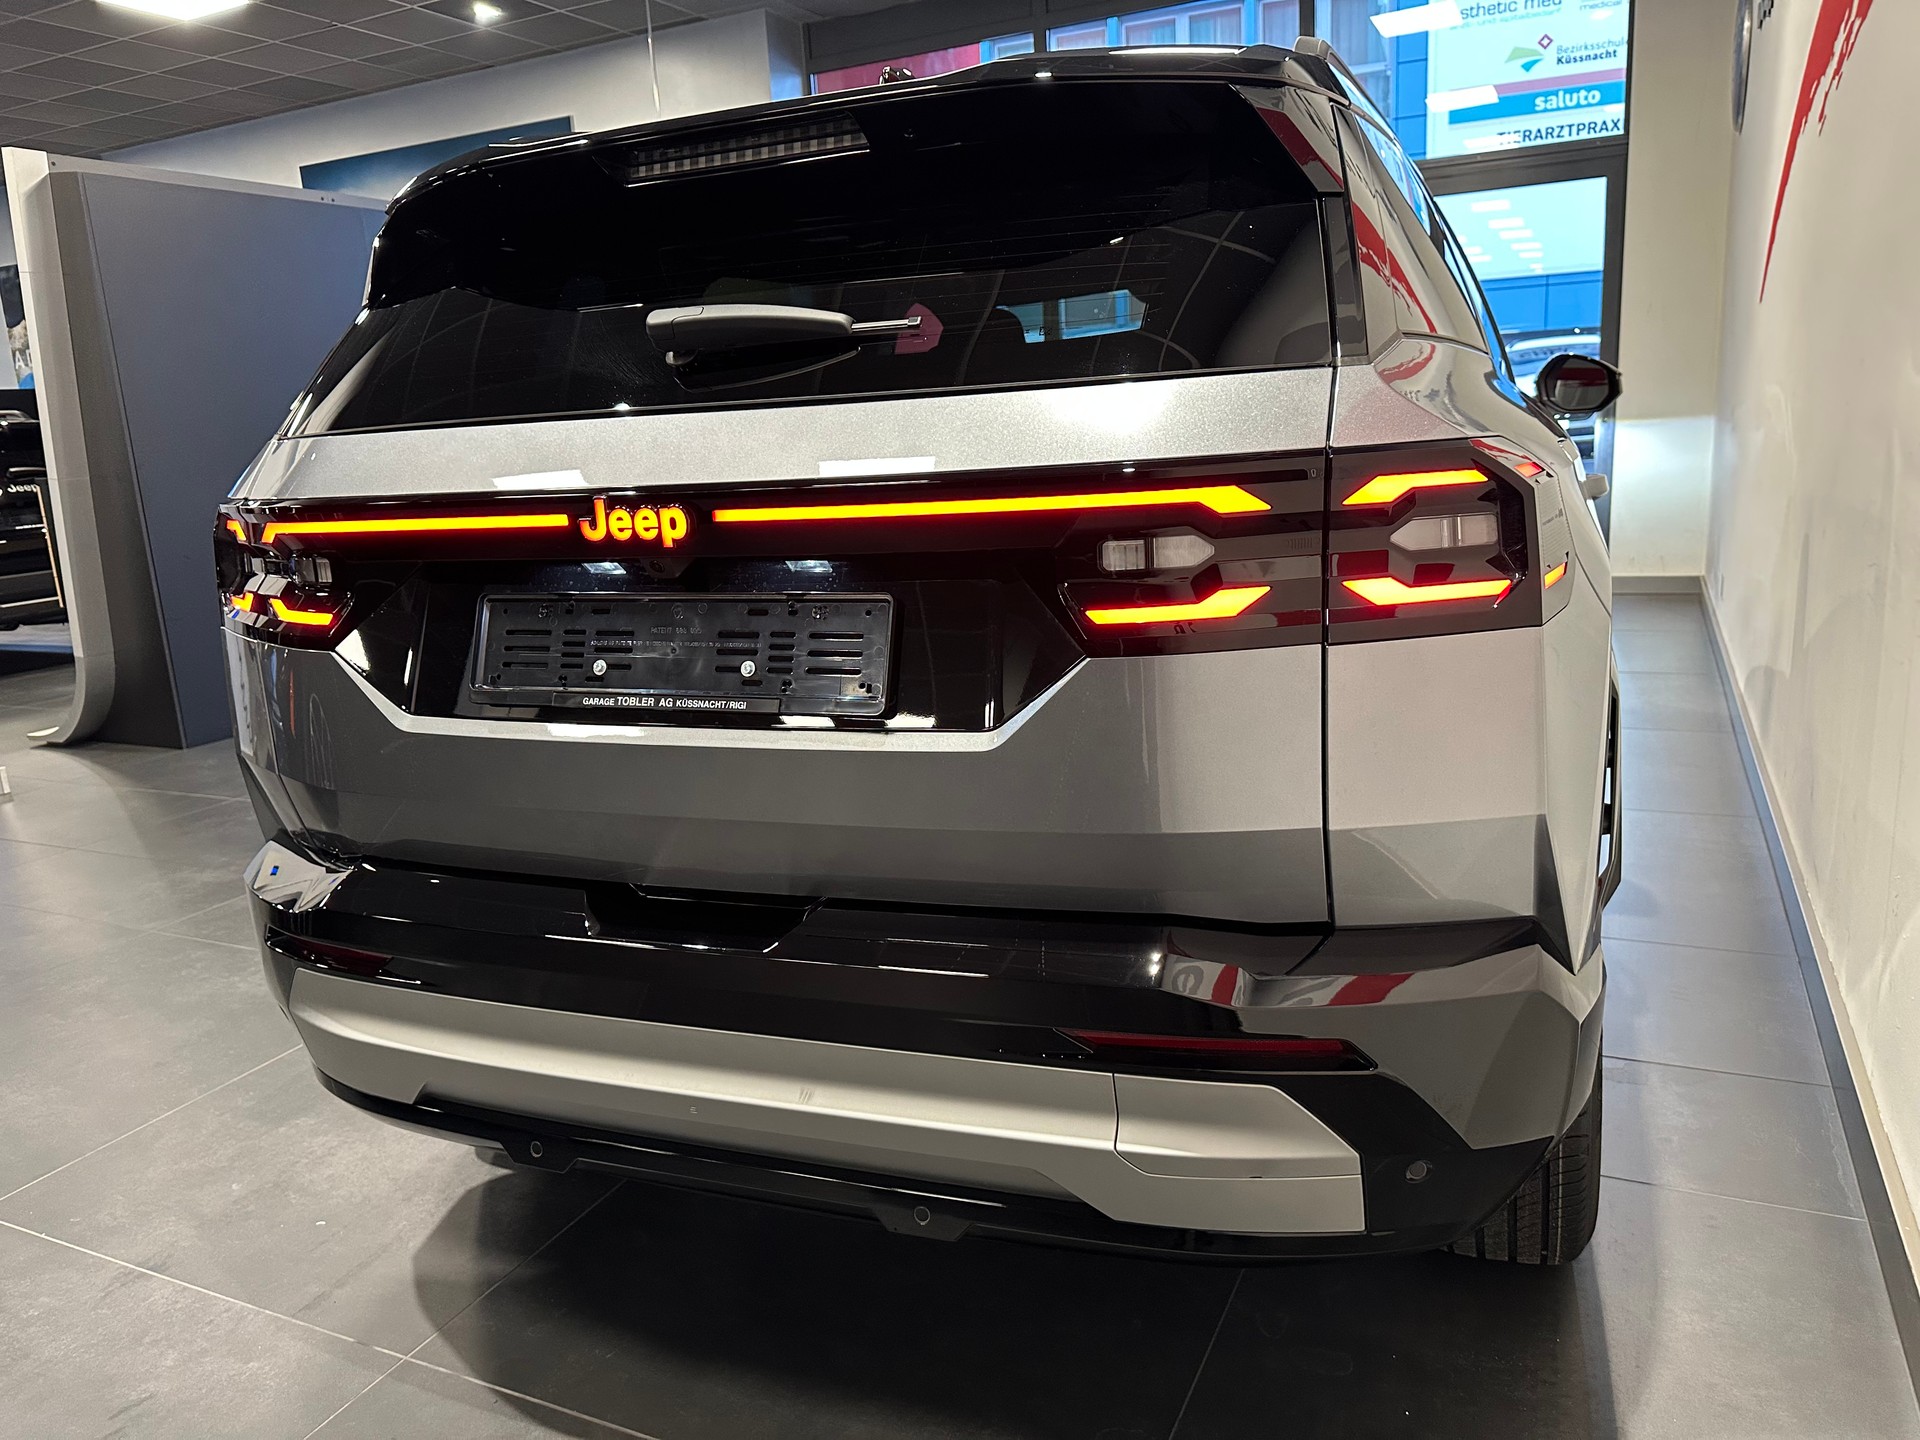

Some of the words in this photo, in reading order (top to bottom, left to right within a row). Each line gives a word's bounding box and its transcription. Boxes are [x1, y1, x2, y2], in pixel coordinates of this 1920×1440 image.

[1556, 36, 1627, 55] Bezirksschul
[1556, 49, 1617, 65] Küssnacht
[1534, 89, 1601, 111] saluto
[579, 496, 688, 548] Jeep
[582, 697, 616, 706] GARAGE
[616, 696, 655, 707] TOBLER
[658, 697, 674, 708] AG
[676, 698, 747, 710] KÜSSNACHT/RIGI
